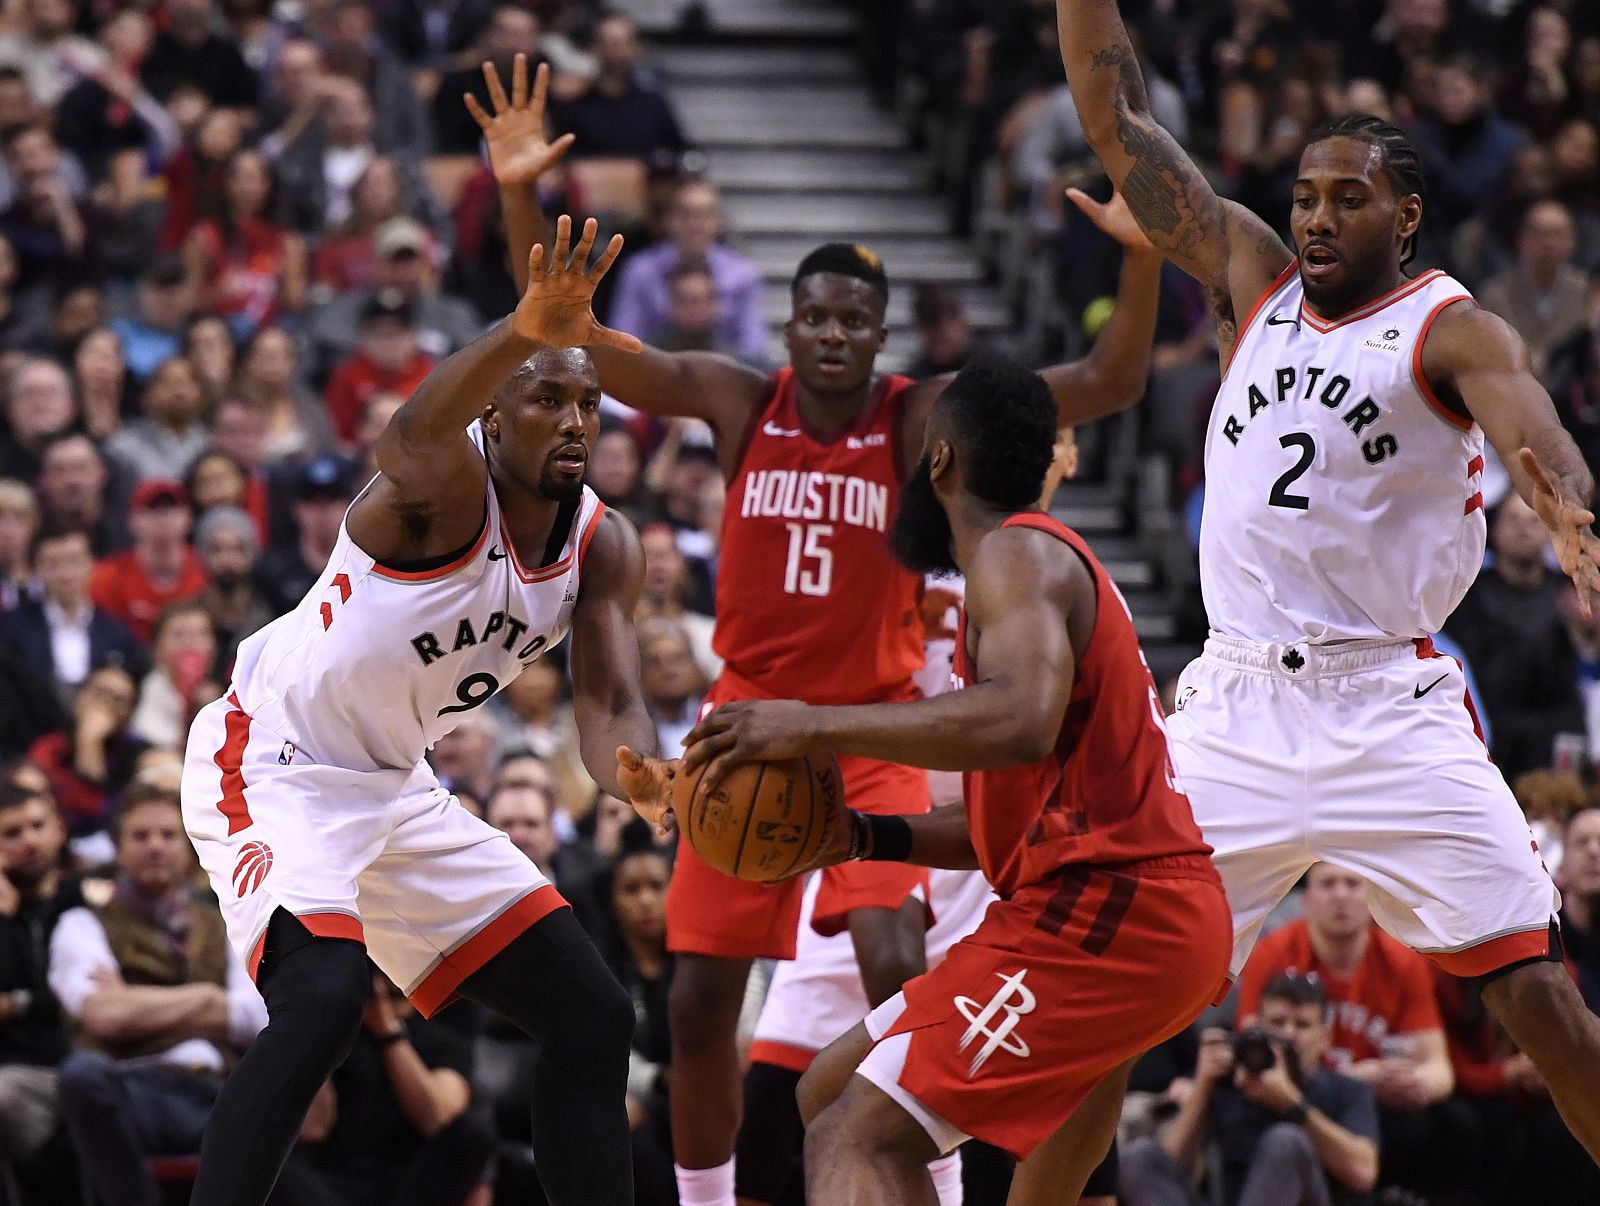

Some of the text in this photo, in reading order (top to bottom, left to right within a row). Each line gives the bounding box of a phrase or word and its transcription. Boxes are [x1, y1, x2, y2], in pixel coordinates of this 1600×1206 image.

[1363, 339, 1400, 352] Sun Life
[1222, 366, 1400, 466] RAPTORS
[740, 469, 889, 533] HOUSTON
[1268, 432, 1316, 510] 2
[783, 521, 834, 597] 15
[562, 592, 575, 602] ife
[410, 610, 549, 670] RAPTO
[436, 672, 499, 718] 9
